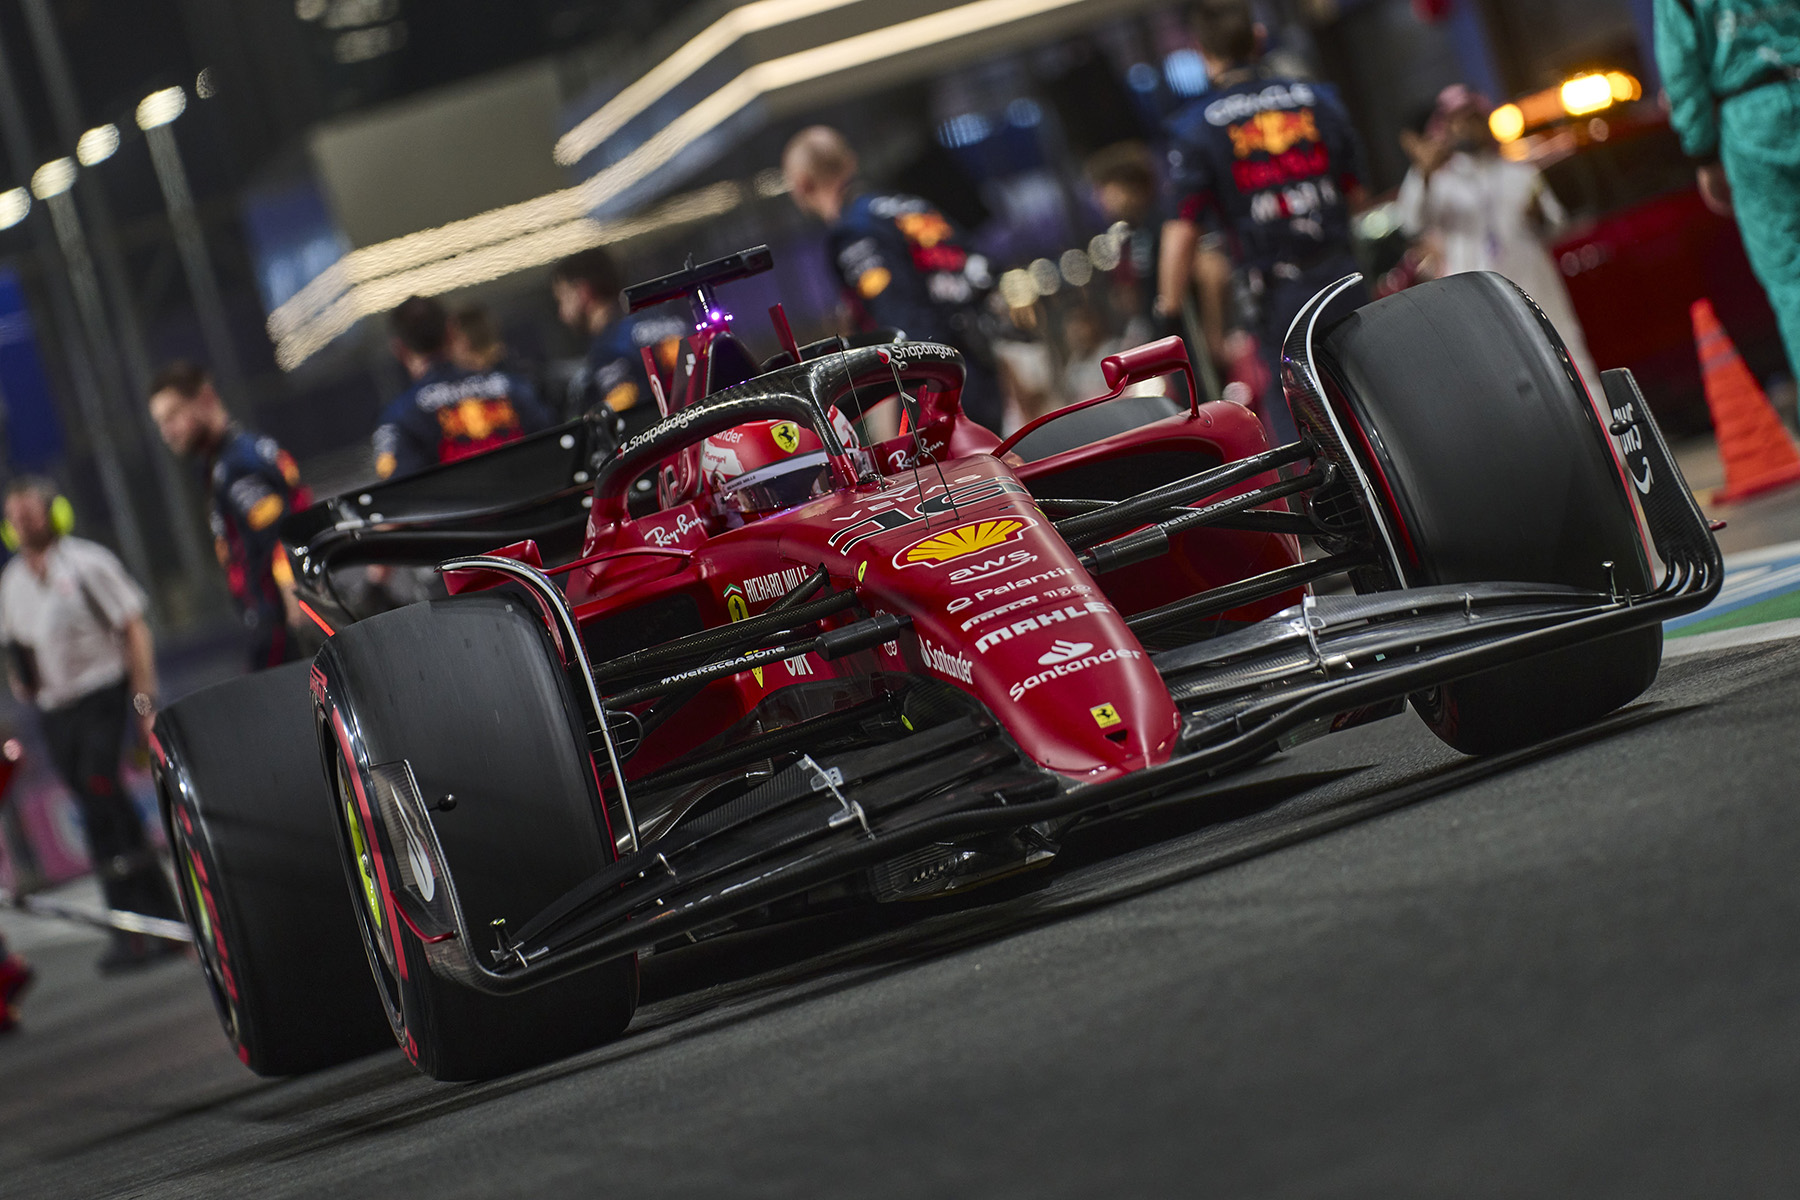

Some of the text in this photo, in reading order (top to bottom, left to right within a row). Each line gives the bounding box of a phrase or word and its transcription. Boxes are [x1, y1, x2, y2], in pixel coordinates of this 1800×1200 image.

[892, 344, 955, 360] Snapdragon
[629, 405, 704, 450] Snapdragon
[644, 514, 703, 547] Ray-Ban
[949, 550, 1031, 581] aws
[743, 572, 785, 603] RICHARD
[975, 567, 1075, 601] Palantir
[975, 601, 1110, 654] MAHLE
[926, 639, 974, 685] Santander
[1009, 648, 1142, 702] Santander
